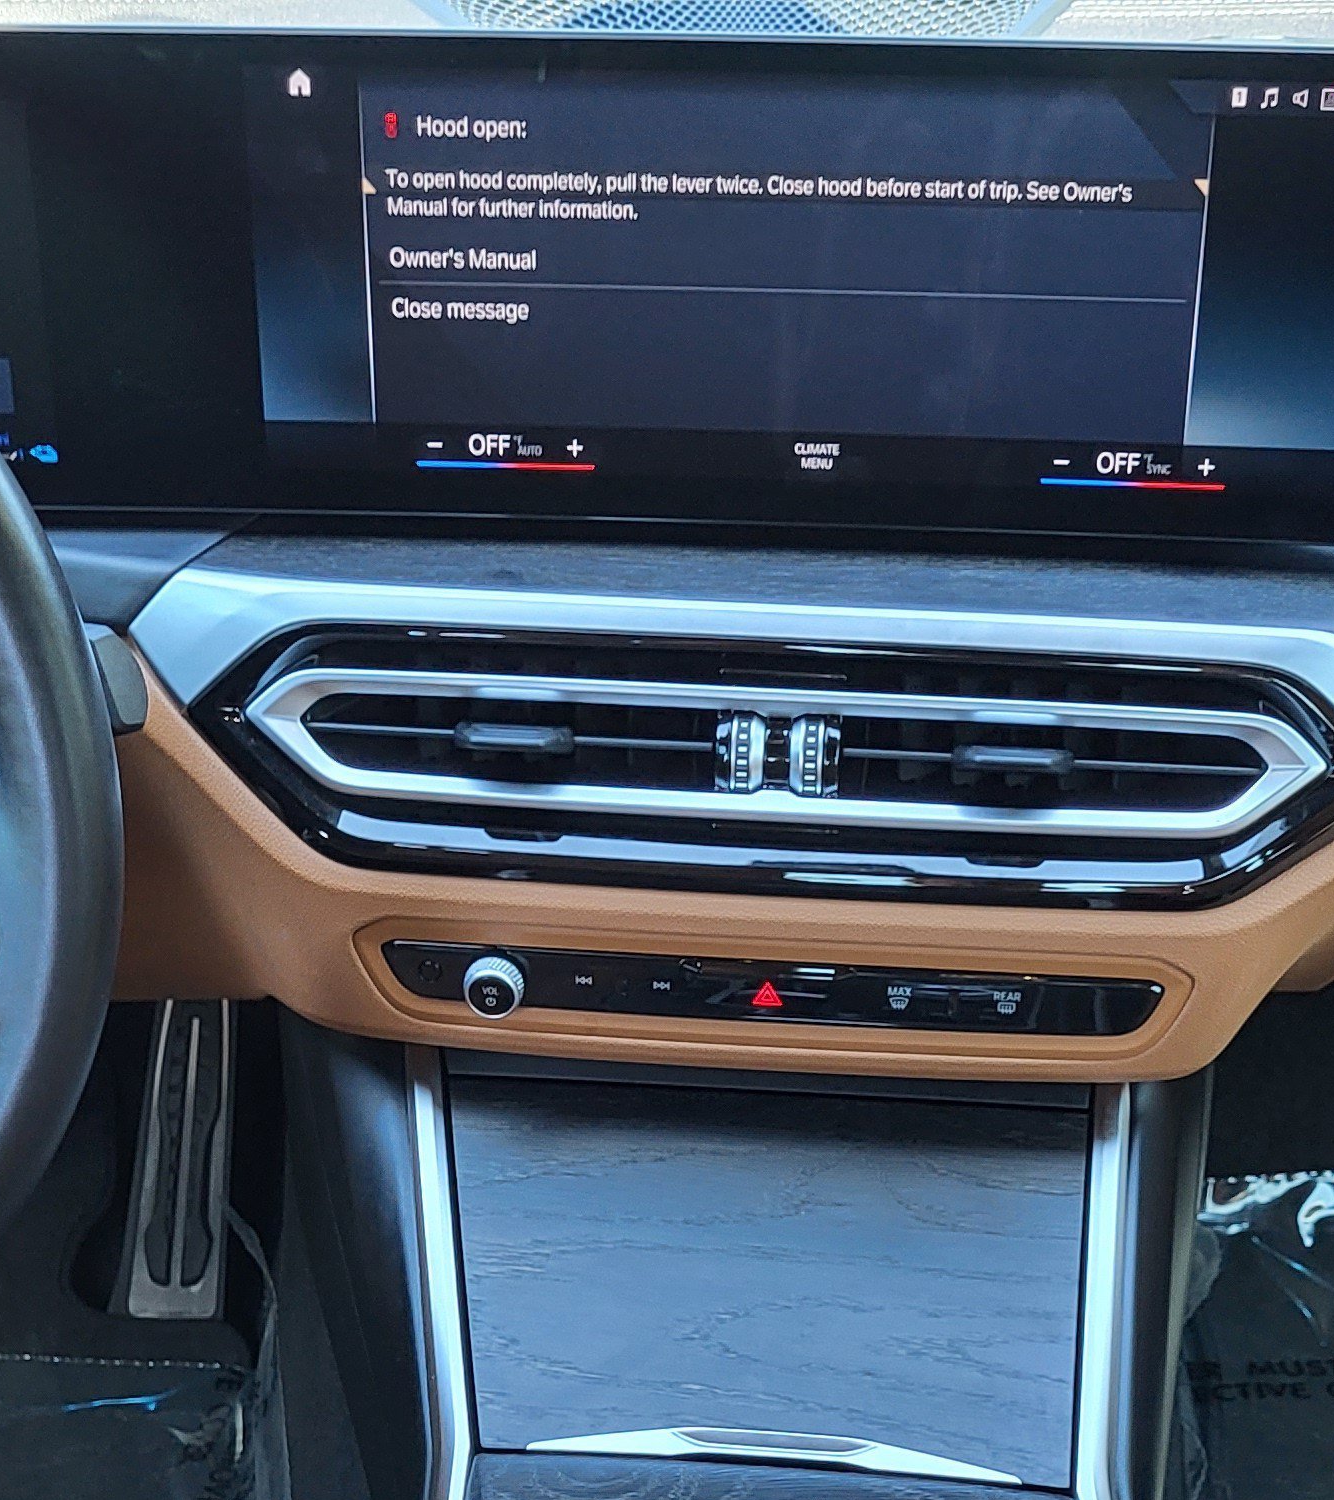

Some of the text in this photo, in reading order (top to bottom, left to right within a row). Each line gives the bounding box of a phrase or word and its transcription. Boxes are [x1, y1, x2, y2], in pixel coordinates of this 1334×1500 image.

[416, 114, 528, 142] Hood open:
[384, 168, 1134, 203] To open hood completely, pull the lever twice. Close hood before start of trip. See Owner's
[387, 196, 639, 221] Manual for further information.
[389, 247, 537, 271] Owner's Manual
[391, 297, 530, 325] Close message
[468, 433, 511, 456] OFF
[793, 442, 841, 457] CLIMATE
[800, 456, 833, 470] MENU
[1096, 452, 1142, 475] OFF
[481, 985, 500, 997] VOL
[887, 985, 912, 997] MAX
[993, 990, 1022, 1002] REAR
